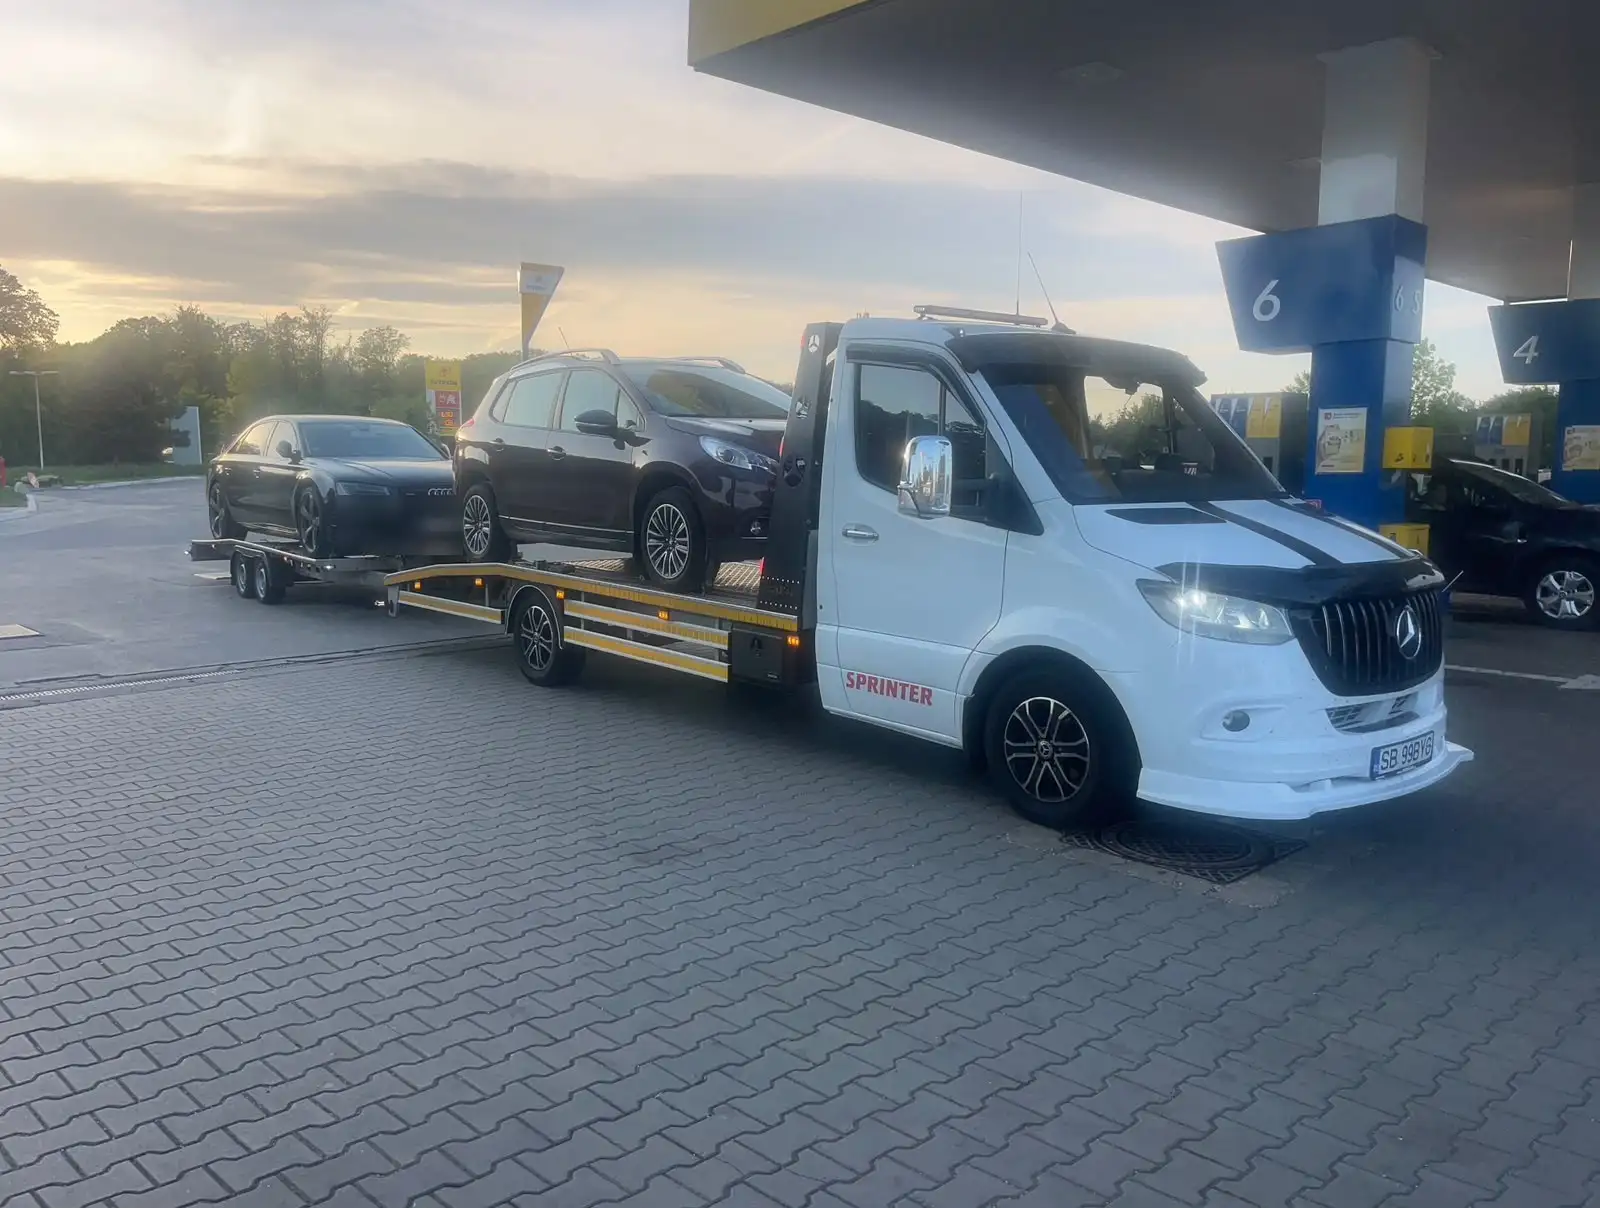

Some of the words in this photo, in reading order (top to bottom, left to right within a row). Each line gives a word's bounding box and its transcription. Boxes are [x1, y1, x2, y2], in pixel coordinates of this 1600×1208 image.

[1253, 280, 1281, 322] 6
[1513, 335, 1539, 365] 4
[846, 671, 933, 706] SPRINTER
[1380, 748, 1398, 770] SB
